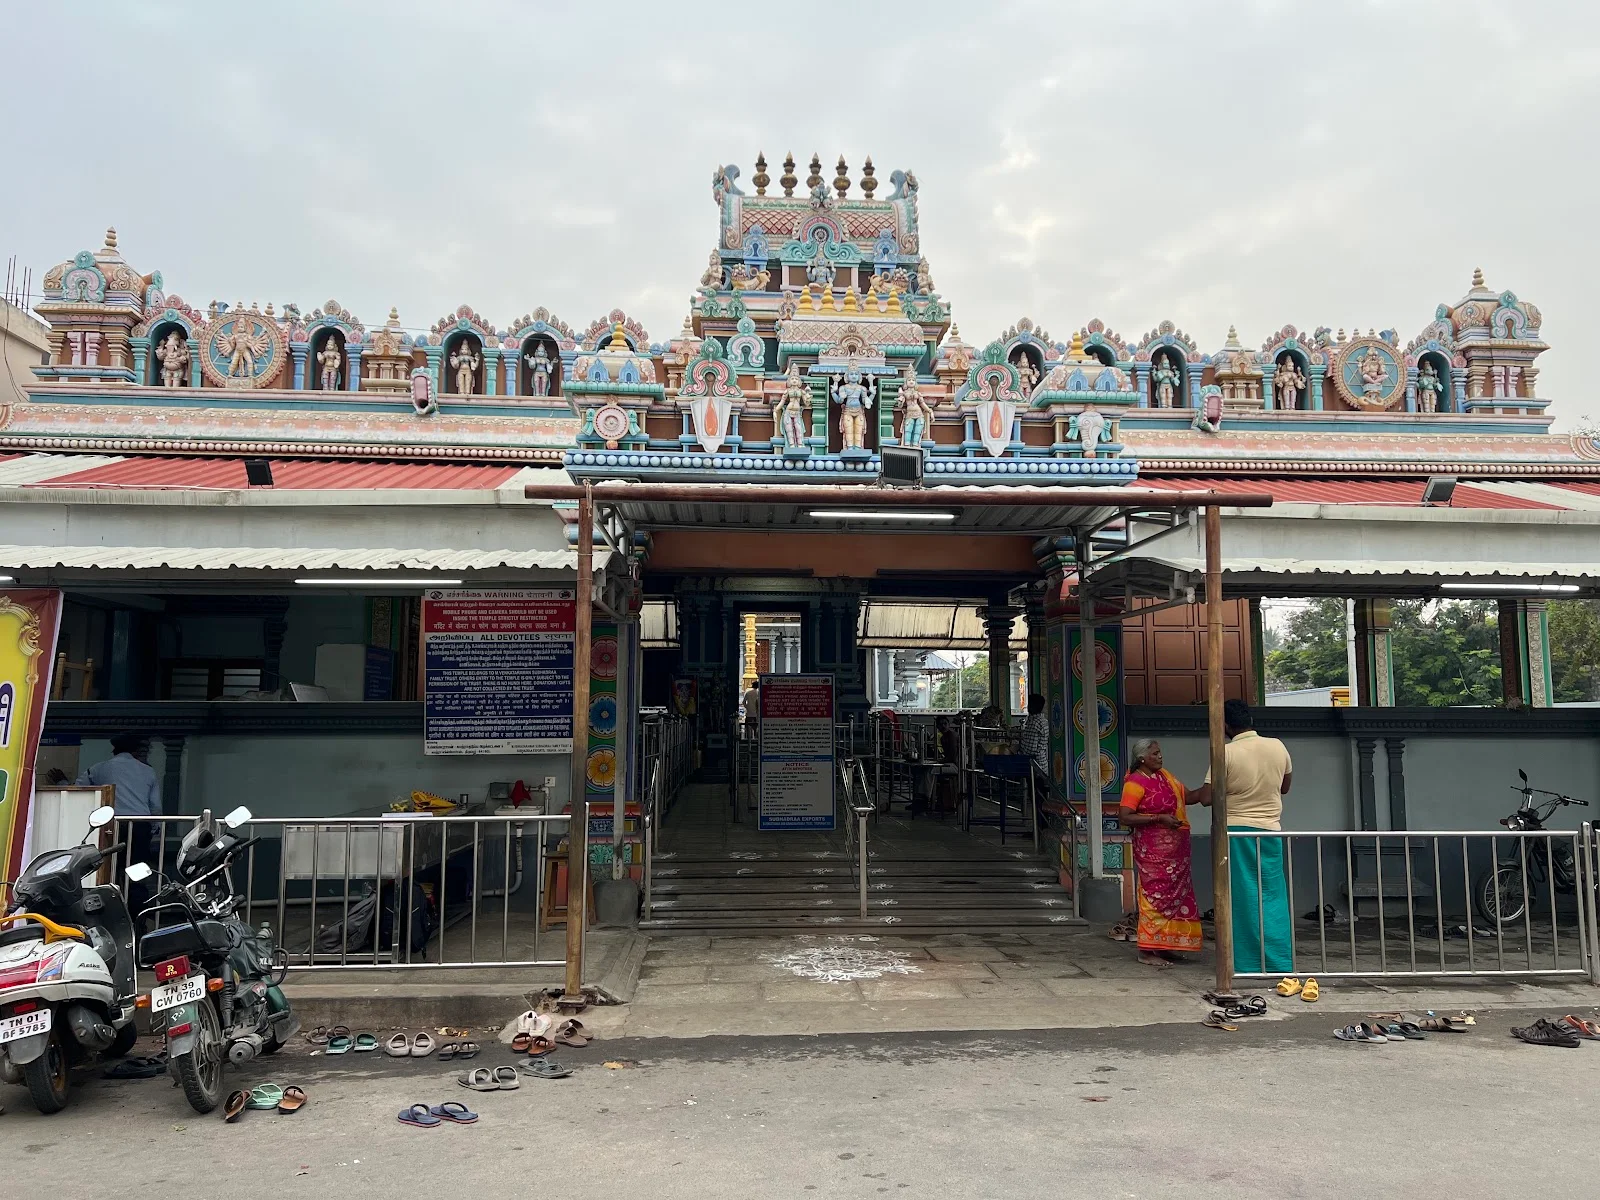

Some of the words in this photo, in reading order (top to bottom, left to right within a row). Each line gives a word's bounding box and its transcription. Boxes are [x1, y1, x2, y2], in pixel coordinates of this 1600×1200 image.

[164, 987, 178, 996] TN
[182, 981, 194, 991] 39
[156, 996, 173, 1008] CW
[176, 988, 202, 1002] 0760
[9, 1018, 23, 1028] TN
[27, 1014, 39, 1023] 01
[3, 1030, 16, 1039] BF
[19, 1023, 46, 1035] 5785
